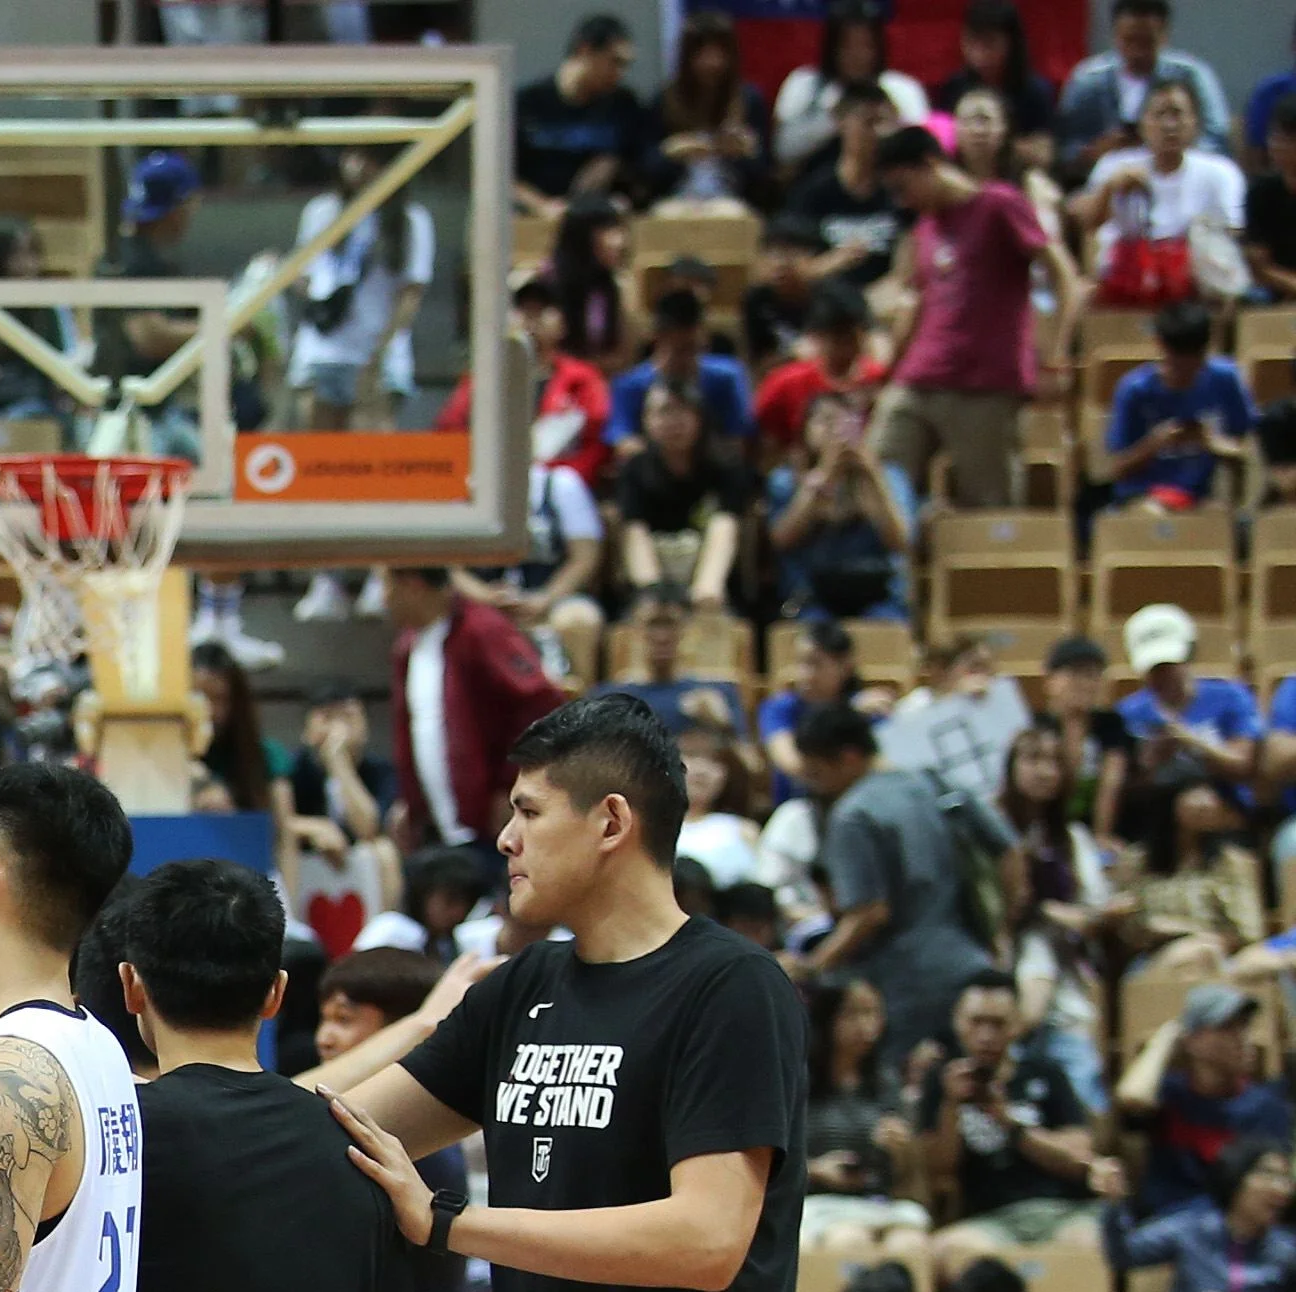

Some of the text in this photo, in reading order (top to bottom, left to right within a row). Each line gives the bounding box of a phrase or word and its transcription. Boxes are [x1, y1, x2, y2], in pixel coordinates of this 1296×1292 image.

[510, 1043, 625, 1087] TOGETHER
[496, 1081, 615, 1130] WE STAND
